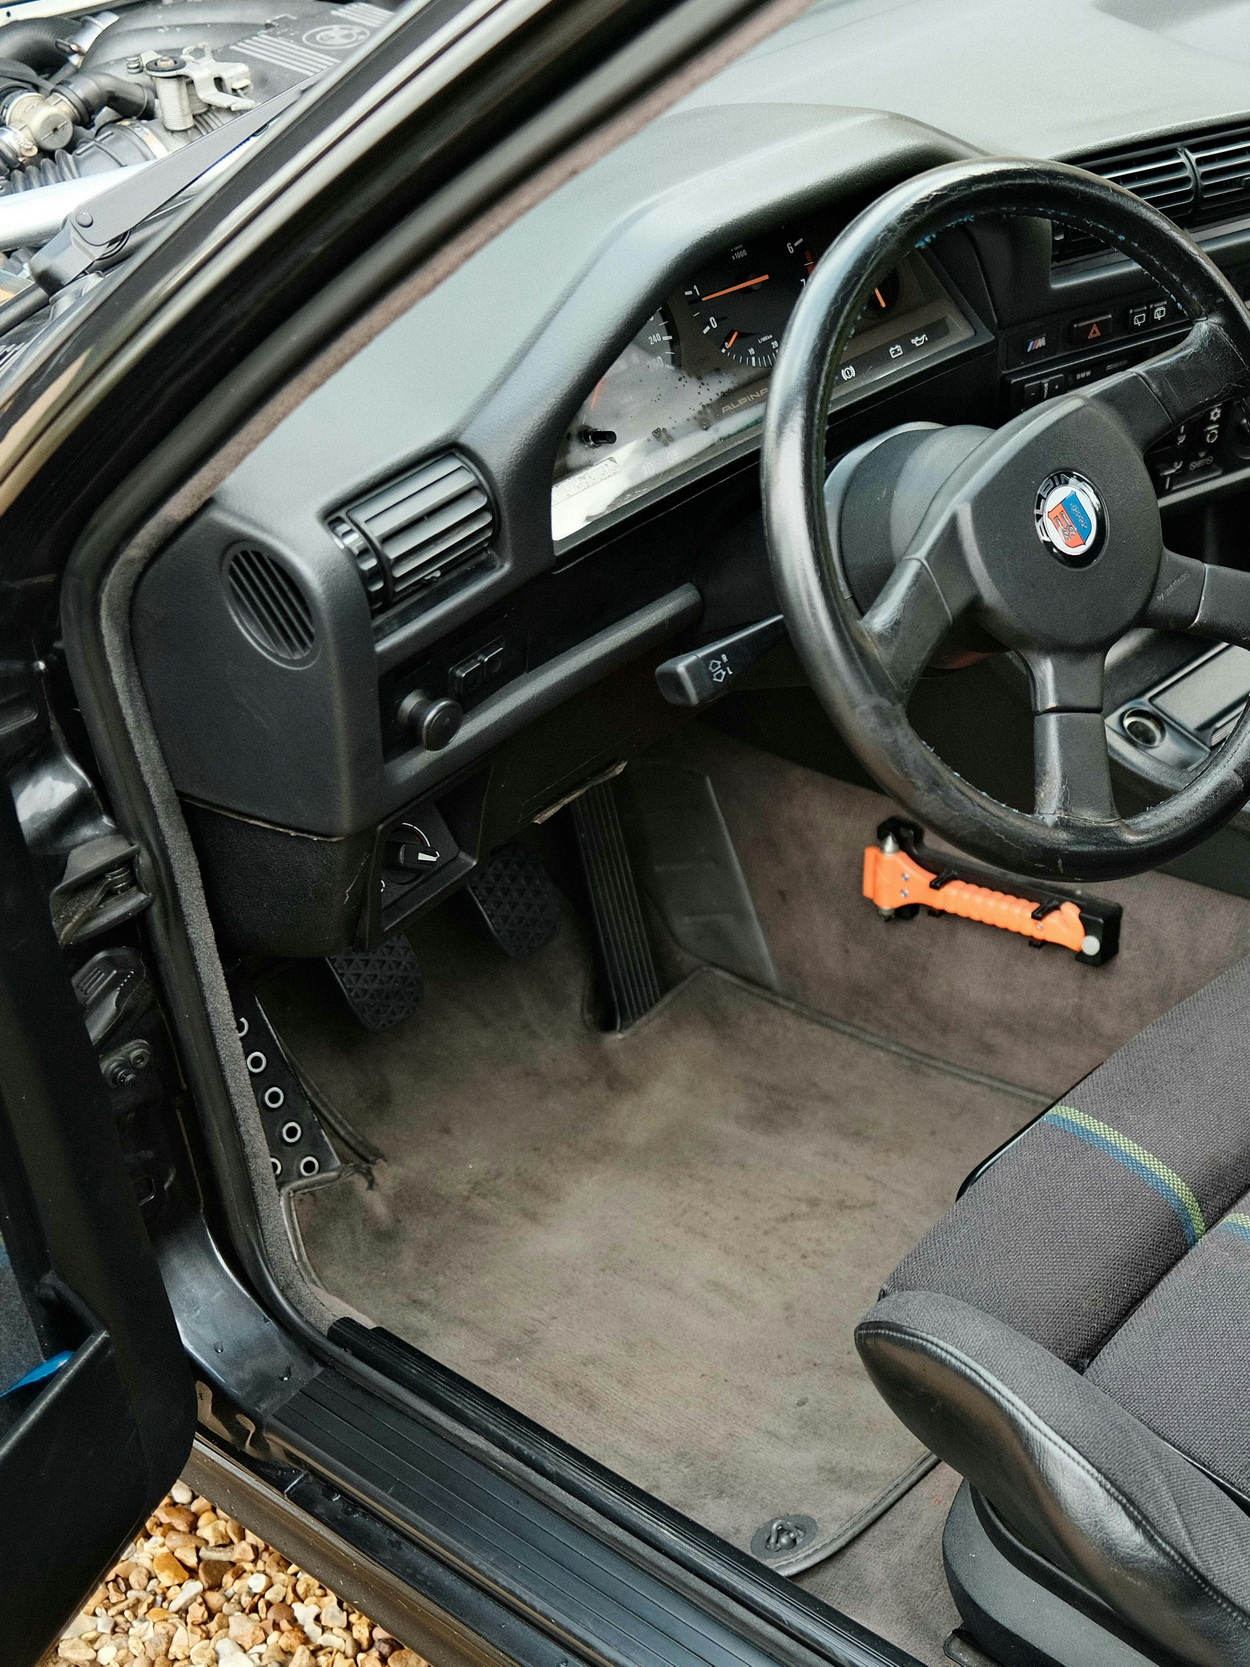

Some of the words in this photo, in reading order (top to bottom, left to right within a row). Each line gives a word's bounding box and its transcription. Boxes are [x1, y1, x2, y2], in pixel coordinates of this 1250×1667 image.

[786, 242, 794, 254] 6
[693, 285, 700, 296] 1
[709, 316, 718, 329] 0
[648, 333, 662, 345] 240
[771, 340, 779, 349] 20
[748, 347, 756, 356] 10
[1076, 370, 1092, 380] BMW
